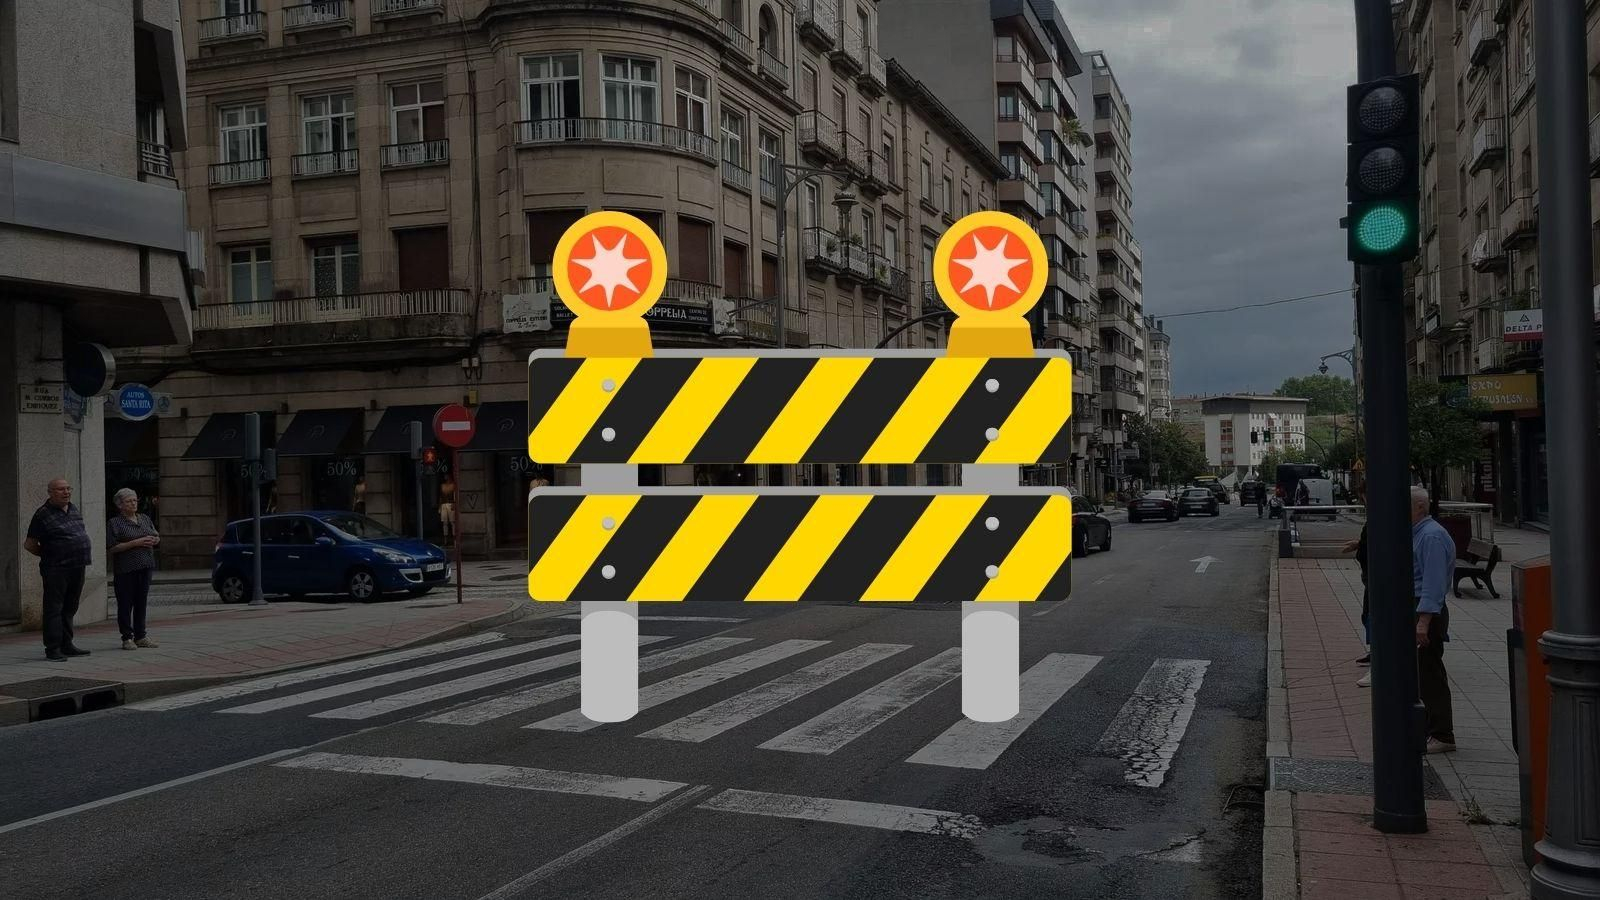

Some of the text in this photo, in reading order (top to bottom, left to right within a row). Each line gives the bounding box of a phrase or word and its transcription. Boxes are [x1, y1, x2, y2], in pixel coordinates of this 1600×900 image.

[645, 305, 687, 319] OPPELIA
[1505, 323, 1542, 332] DELTA P
[126, 391, 145, 399] AUTOS
[121, 399, 151, 408] SANTA RITA
[328, 461, 357, 477] 50%
